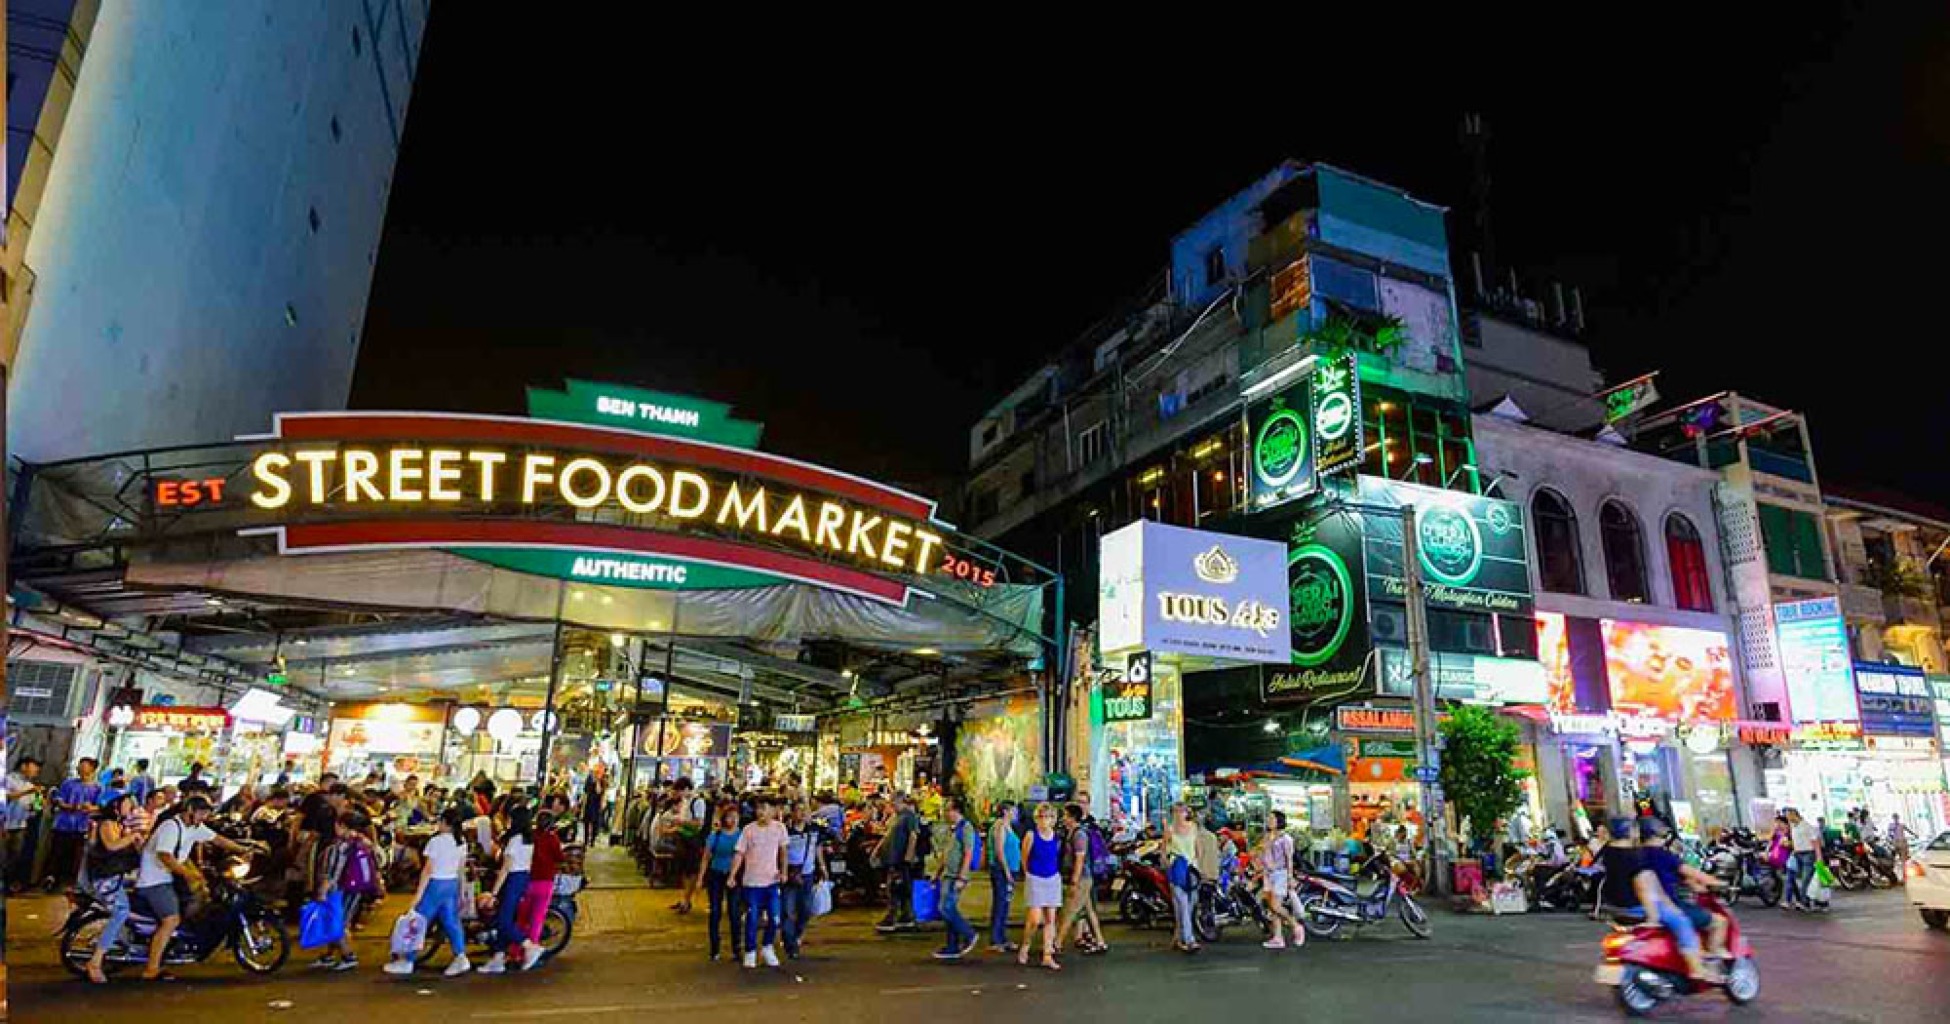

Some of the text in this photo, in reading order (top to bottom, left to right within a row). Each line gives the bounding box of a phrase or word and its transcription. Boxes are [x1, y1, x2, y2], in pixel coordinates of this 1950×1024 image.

[596, 396, 700, 427] BEN THANH
[156, 478, 226, 505] EST
[251, 450, 942, 574] STREET FOOD MARKET
[571, 556, 687, 583] AUTHENTIC
[940, 554, 995, 588] 2015
[1157, 591, 1230, 625] TOUS
[1104, 697, 1146, 719] TOUS
